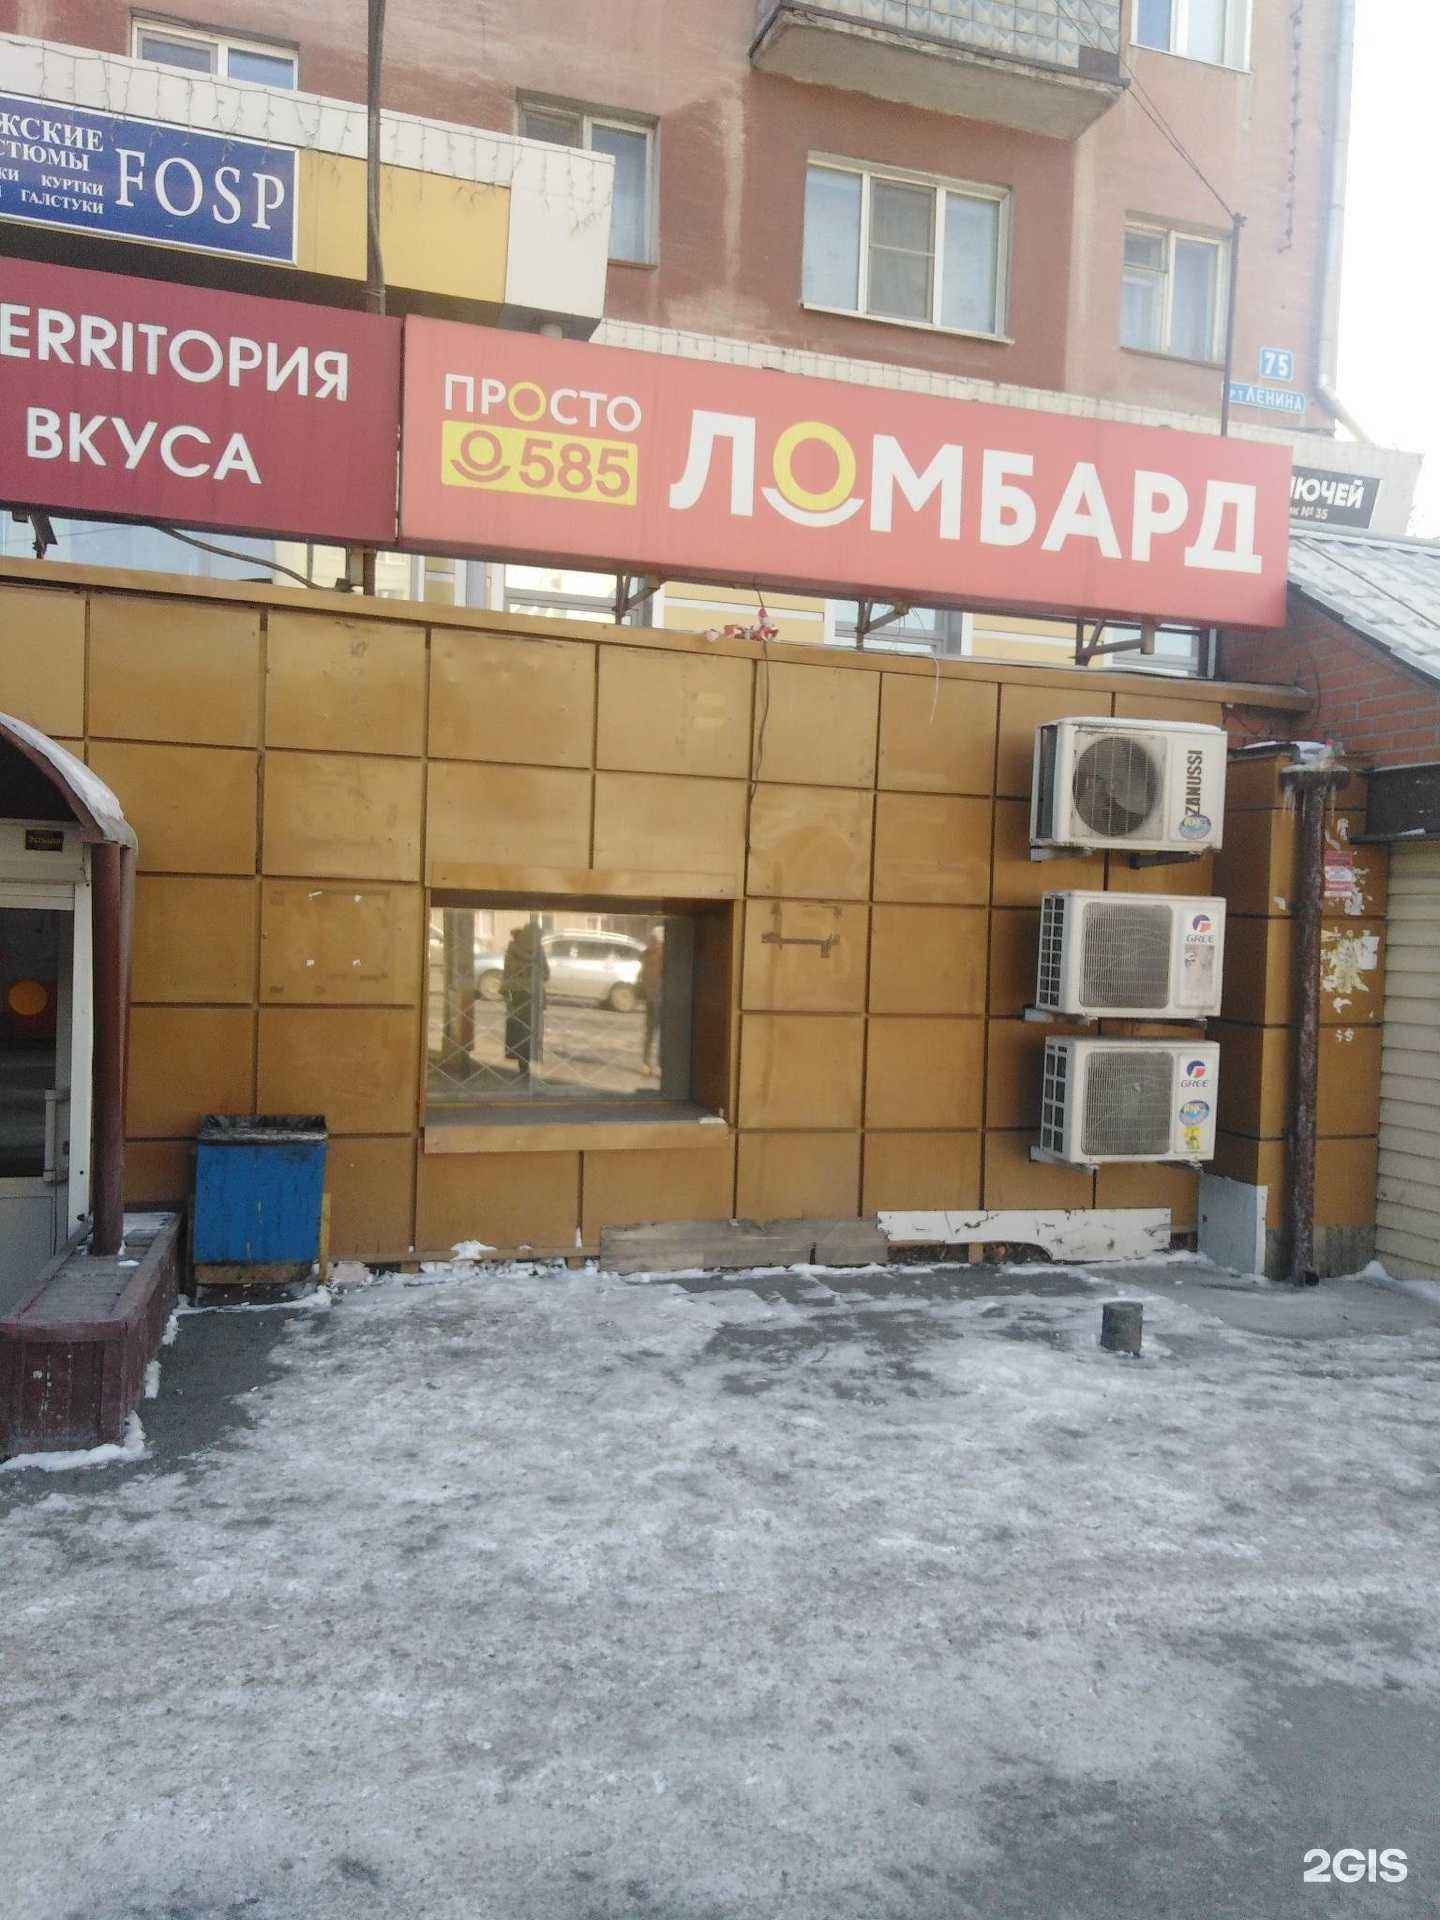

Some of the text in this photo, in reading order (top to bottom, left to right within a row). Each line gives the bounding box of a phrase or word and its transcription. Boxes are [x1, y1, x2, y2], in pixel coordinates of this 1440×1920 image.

[20, 189, 104, 214] ГАЛСТУКИ
[41, 174, 104, 197] КУРТКИ
[114, 148, 285, 230] FOSP
[1263, 352, 1289, 377] 75
[444, 373, 642, 432] ПРОСТО
[1246, 386, 1302, 411] ЛЕНИНА
[26, 406, 262, 484] ВКУСА
[669, 409, 1263, 575] ЛОМБАРД
[1185, 750, 1203, 818] ZANUSSI
